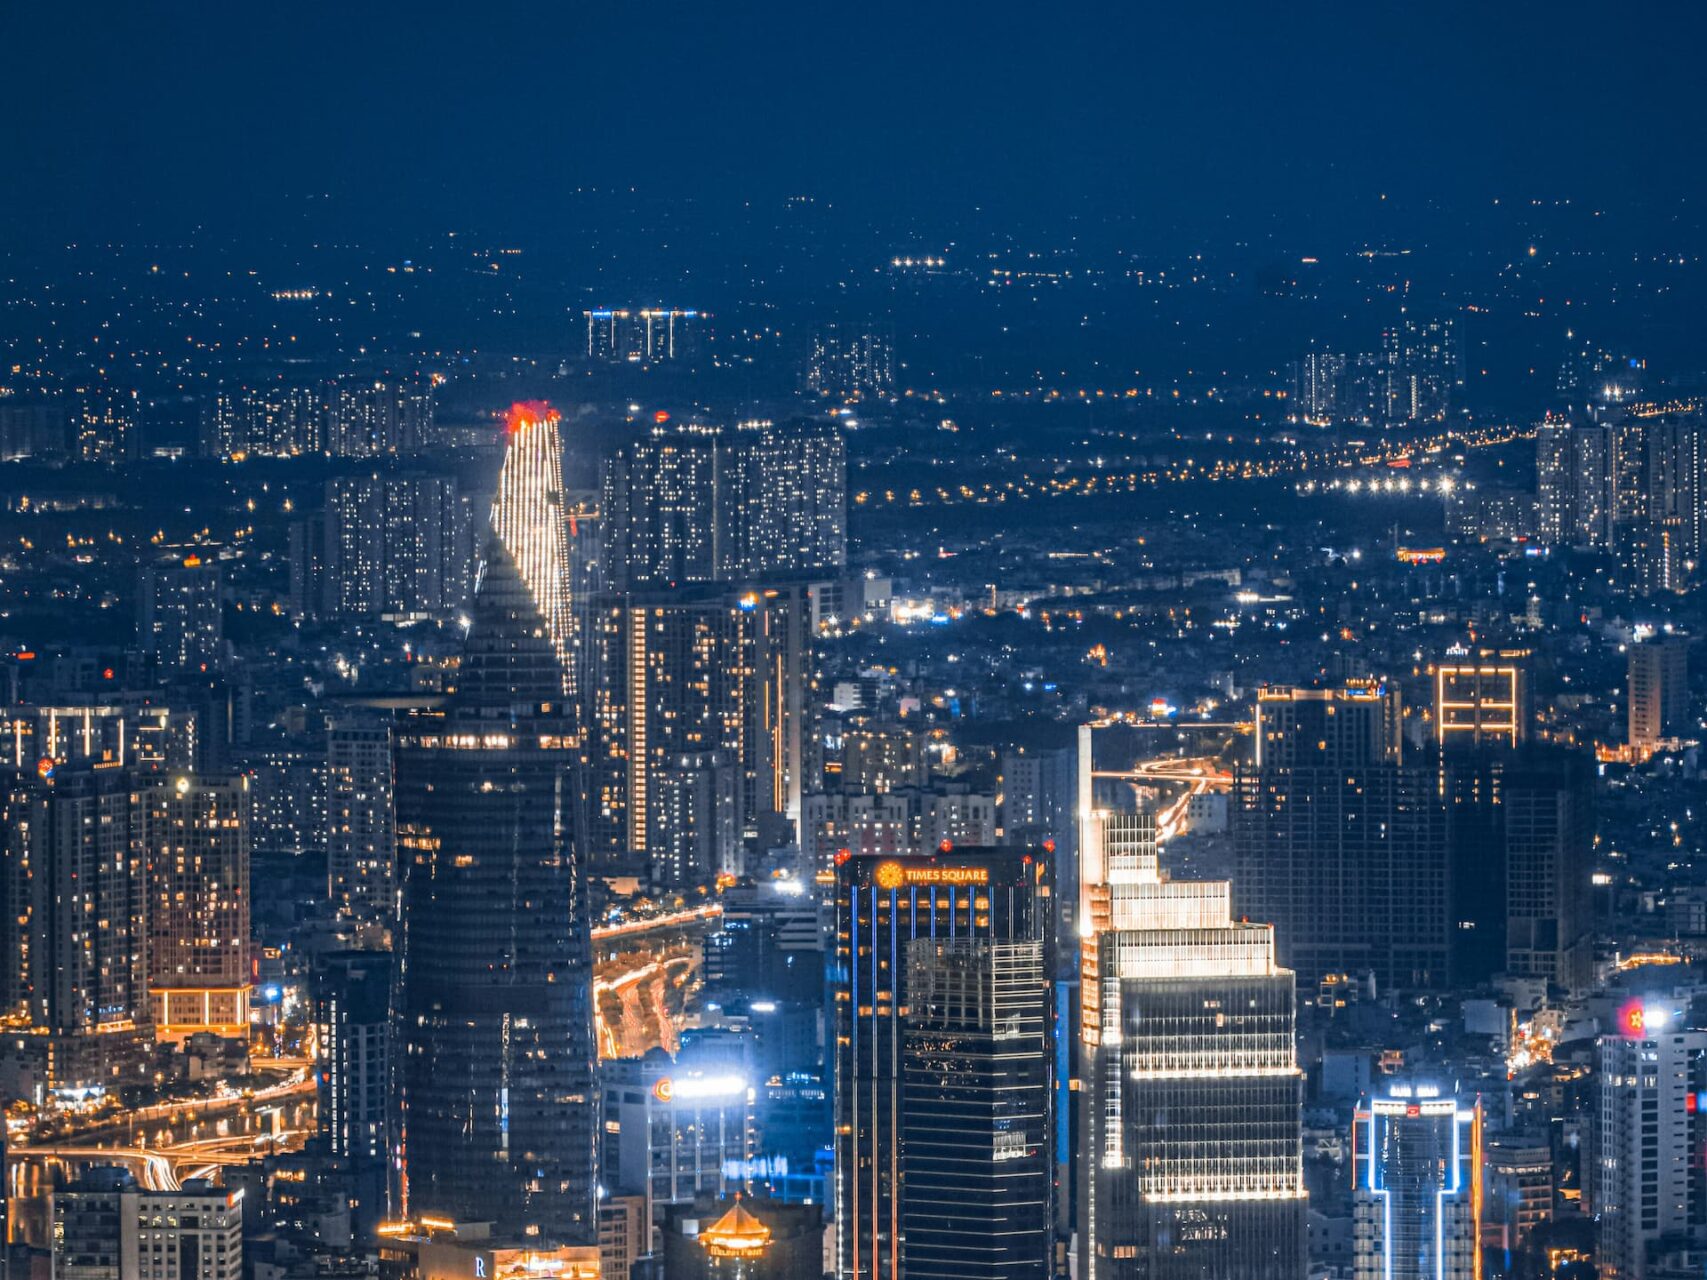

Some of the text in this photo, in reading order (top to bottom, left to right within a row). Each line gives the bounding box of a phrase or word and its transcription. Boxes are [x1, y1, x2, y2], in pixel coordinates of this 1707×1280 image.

[905, 870, 988, 882] TIMES SQUARE
[475, 1257, 486, 1278] R
